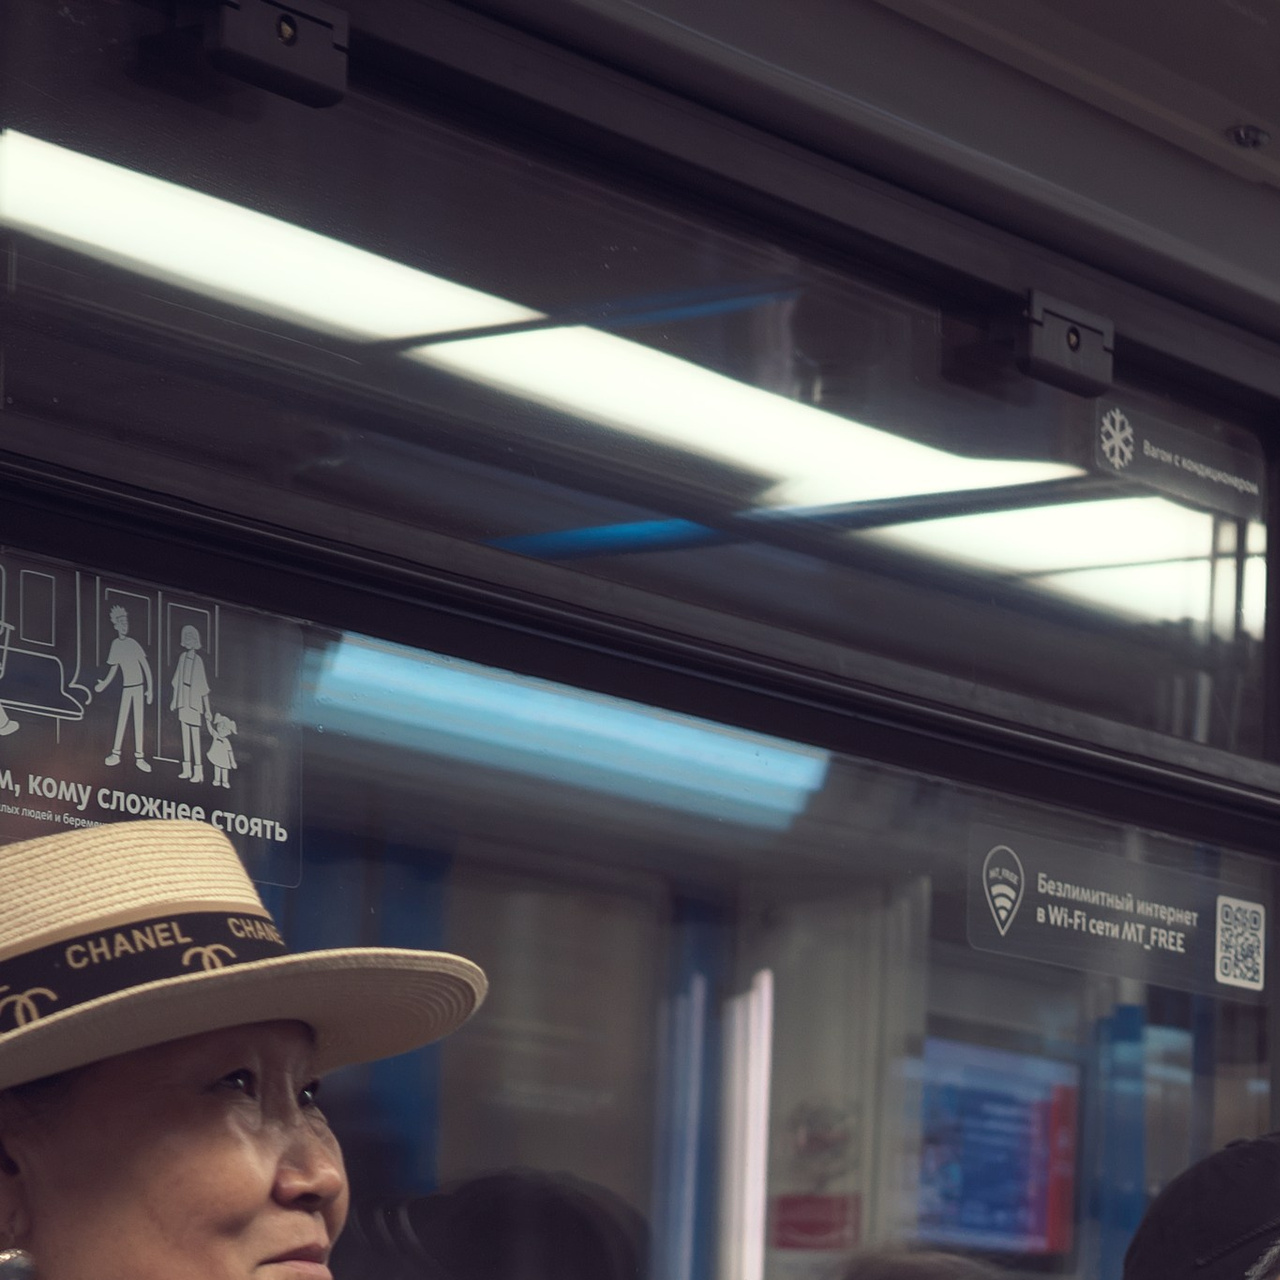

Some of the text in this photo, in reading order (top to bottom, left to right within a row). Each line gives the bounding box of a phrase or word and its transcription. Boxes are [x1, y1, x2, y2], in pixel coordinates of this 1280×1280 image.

[0, 803, 20, 816] лых
[21, 807, 53, 822] людей
[54, 814, 61, 823] и
[28, 773, 92, 811] кому
[97, 787, 206, 821] сложнее
[211, 810, 288, 842] стоять
[1037, 872, 1199, 928] Безлимитный интернет
[65, 921, 193, 969] CHANEL
[1036, 904, 1186, 953] в Wi-Fi сети MT_FREE
